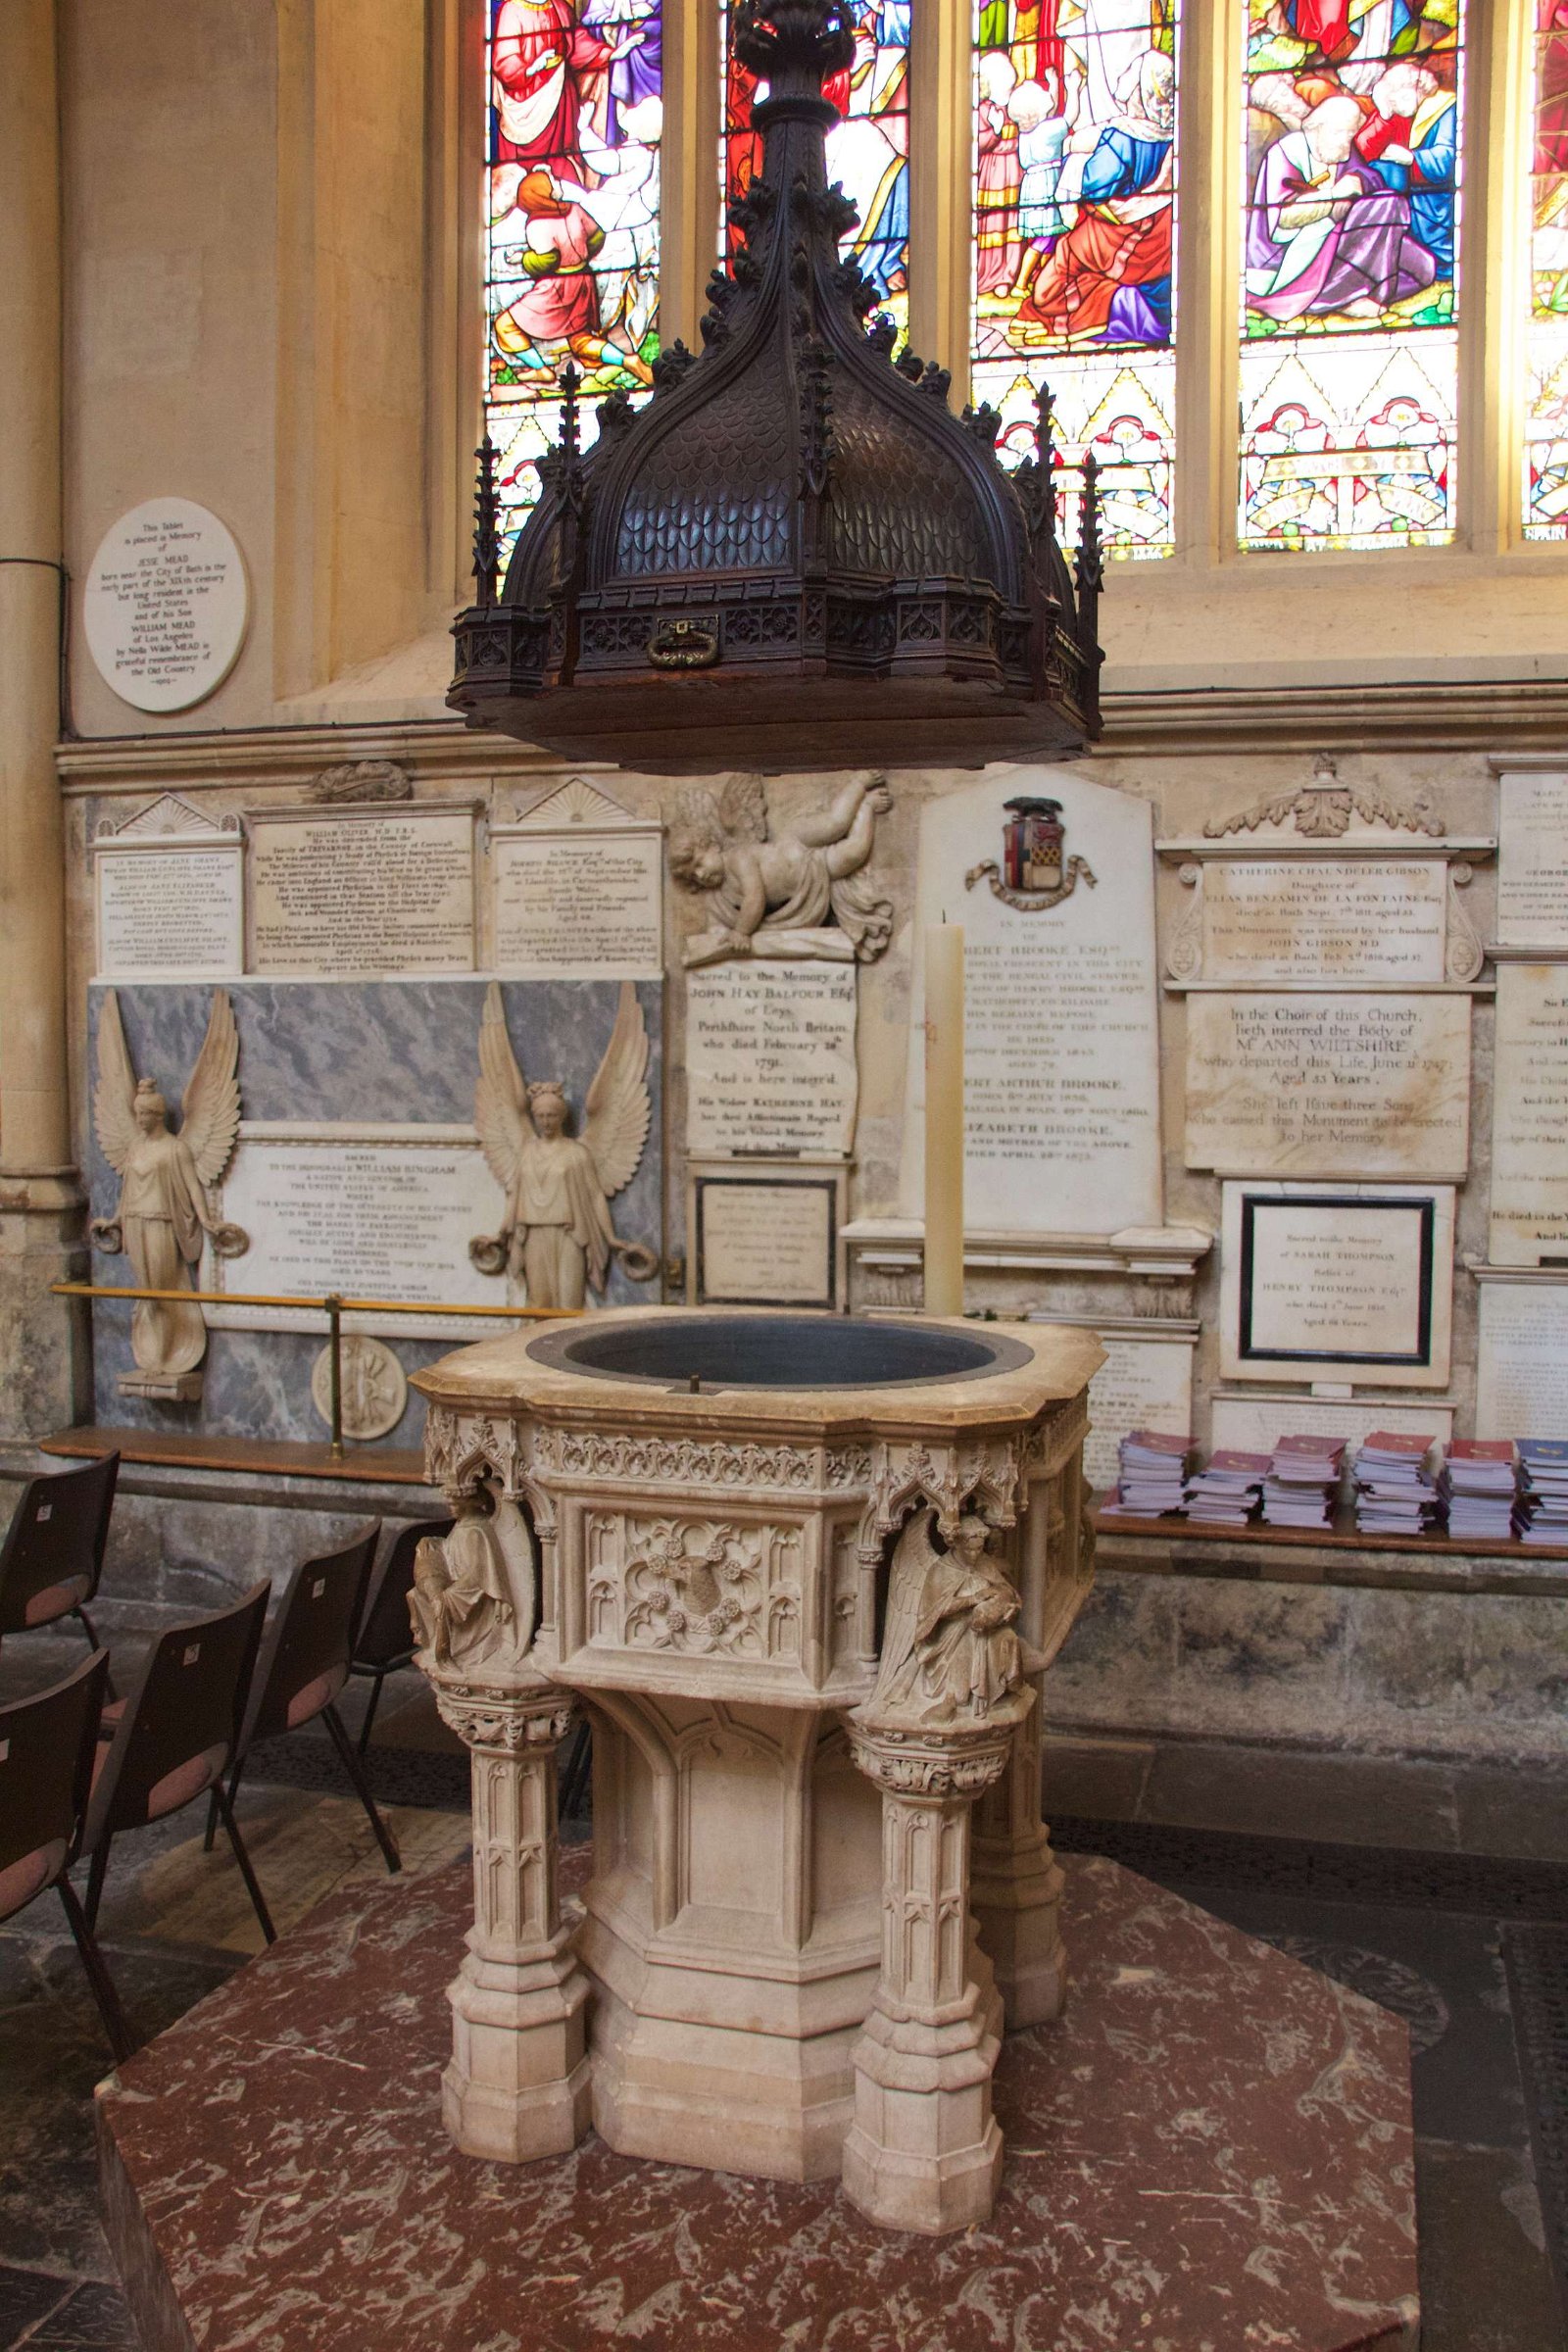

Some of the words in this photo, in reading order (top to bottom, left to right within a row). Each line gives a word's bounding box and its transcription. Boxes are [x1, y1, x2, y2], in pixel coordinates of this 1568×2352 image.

[133, 535, 157, 545] placed
[170, 532, 201, 541] Memory
[138, 557, 159, 566] JESSE
[166, 555, 188, 564] MEAD
[156, 567, 171, 577] City
[133, 593, 149, 602] long
[132, 623, 167, 632] WILLIAM
[172, 620, 196, 629] MEAD
[163, 633, 193, 644] Angeles
[175, 642, 199, 651] MEAD
[165, 665, 195, 674] Country
[1220, 867, 1293, 876] CATHERINE
[1386, 867, 1430, 876] GIBSON
[1398, 926, 1439, 935] husband
[1268, 939, 1300, 948] JOHN
[1306, 939, 1352, 948] GIBSON
[693, 971, 732, 982] Sacred
[758, 971, 775, 981] the
[784, 970, 830, 985] Memory
[690, 989, 725, 999] JOHN
[731, 988, 760, 999] HAY
[764, 988, 824, 999] BALFOUR
[745, 1005, 759, 1015] of
[1250, 1008, 1269, 1020] the
[1274, 1008, 1312, 1020] Choir
[1335, 1009, 1359, 1020] this
[763, 1021, 799, 1032] North
[1271, 1025, 1322, 1036] interred
[1329, 1025, 1350, 1036] the
[1358, 1026, 1394, 1039] Body
[1400, 1026, 1414, 1036] of
[731, 1039, 758, 1049] died
[763, 1039, 816, 1054] February
[1262, 1039, 1299, 1052] ANN
[1310, 1040, 1407, 1053] WILTSHIRE
[1202, 1056, 1234, 1068] who
[1239, 1055, 1298, 1073] departed
[1306, 1055, 1331, 1067] this
[1371, 1055, 1400, 1072] June
[711, 1073, 736, 1084] And
[760, 1074, 786, 1084] here
[998, 1078, 1055, 1089] ARTHUR
[1268, 1071, 1305, 1086] Aged
[754, 1098, 813, 1107] KATHERINE
[1243, 1097, 1268, 1110] She
[1277, 1097, 1298, 1110] left
[1343, 1098, 1376, 1110] three
[1222, 1115, 1264, 1127] caused
[1272, 1115, 1295, 1127] this
[1303, 1114, 1369, 1127] Monument
[1414, 1117, 1462, 1130] erected
[1281, 1130, 1296, 1143] to
[1301, 1129, 1323, 1143] her
[1329, 1129, 1385, 1148] Memory
[356, 1163, 401, 1173] WILLIAM
[404, 1165, 456, 1176] BINGHAM
[1294, 1251, 1330, 1260] SARAH
[1337, 1252, 1396, 1261] THOMPSON
[1263, 1283, 1301, 1292] HENRY
[1310, 1285, 1375, 1294] THOMPSON
